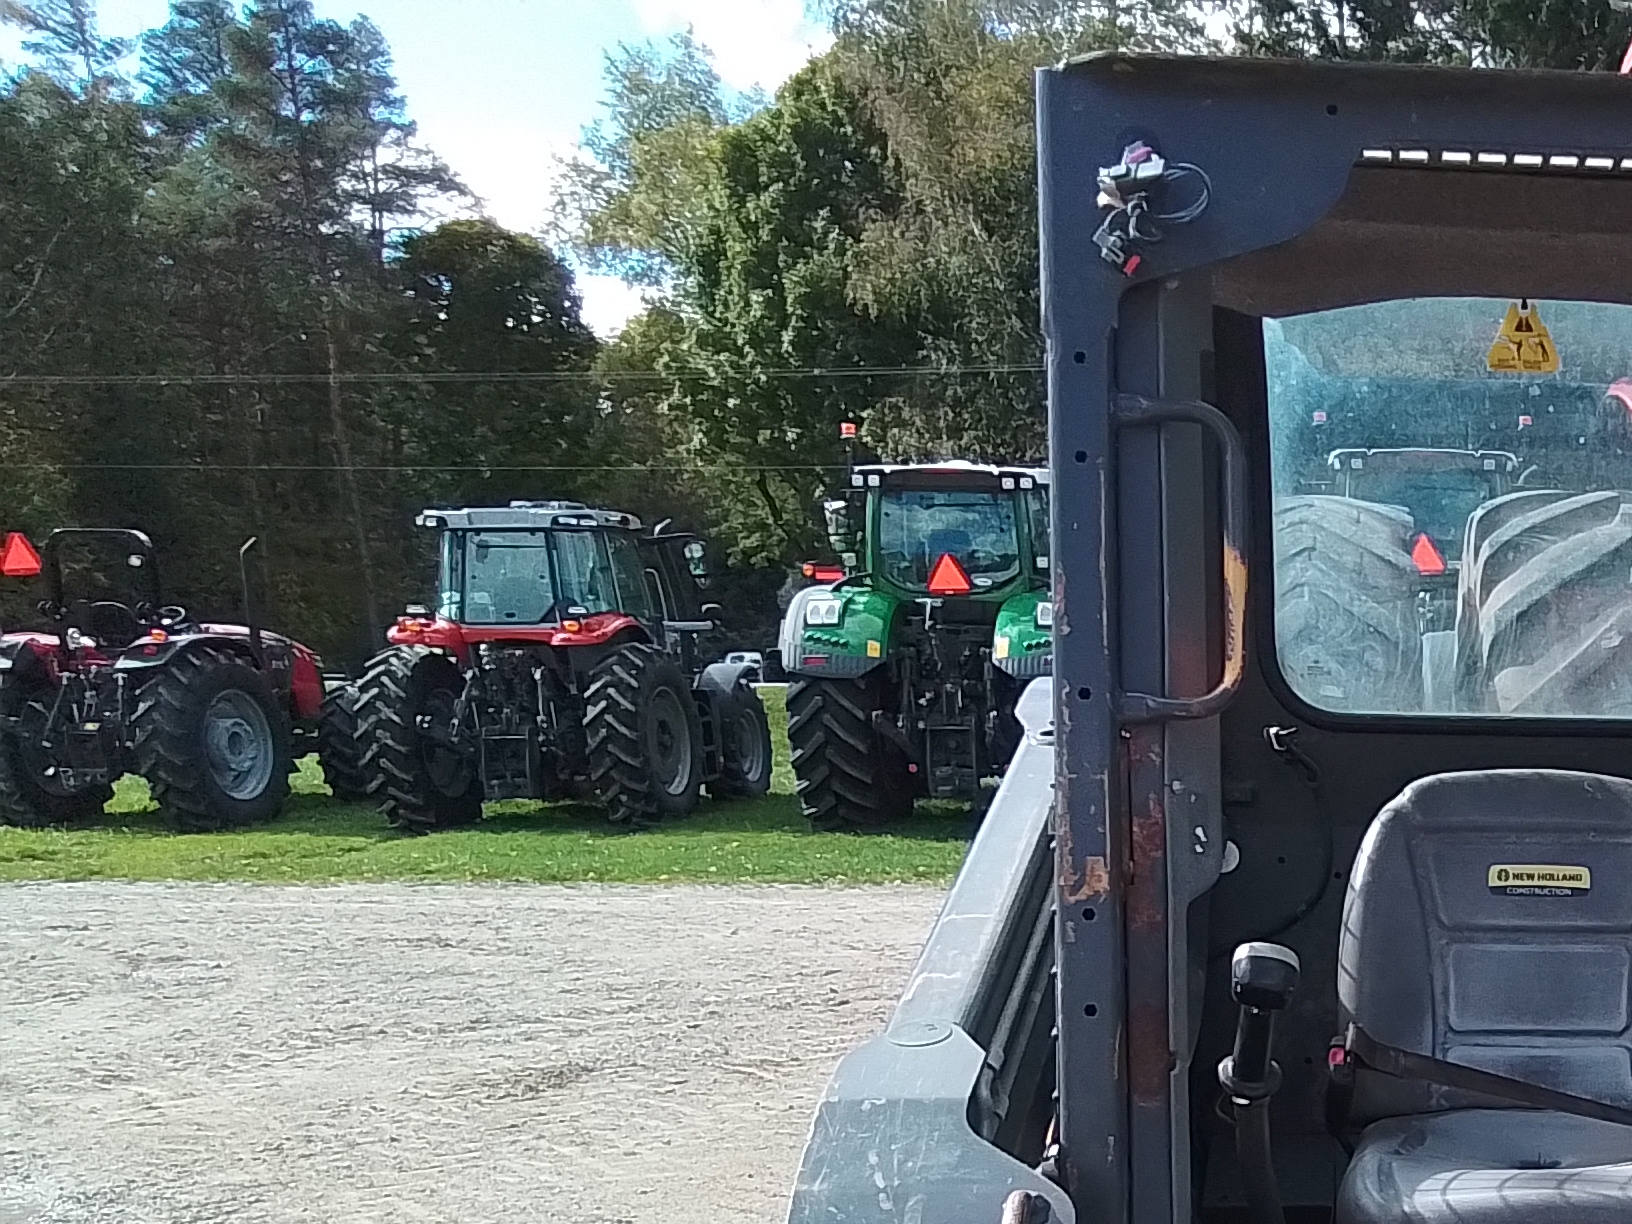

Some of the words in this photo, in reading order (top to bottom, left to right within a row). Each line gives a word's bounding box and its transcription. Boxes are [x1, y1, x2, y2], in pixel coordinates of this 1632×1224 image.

[1511, 872, 1536, 883] NEW
[1536, 872, 1583, 883] HOLLAND
[1506, 886, 1572, 896] CONSTRUCTION
